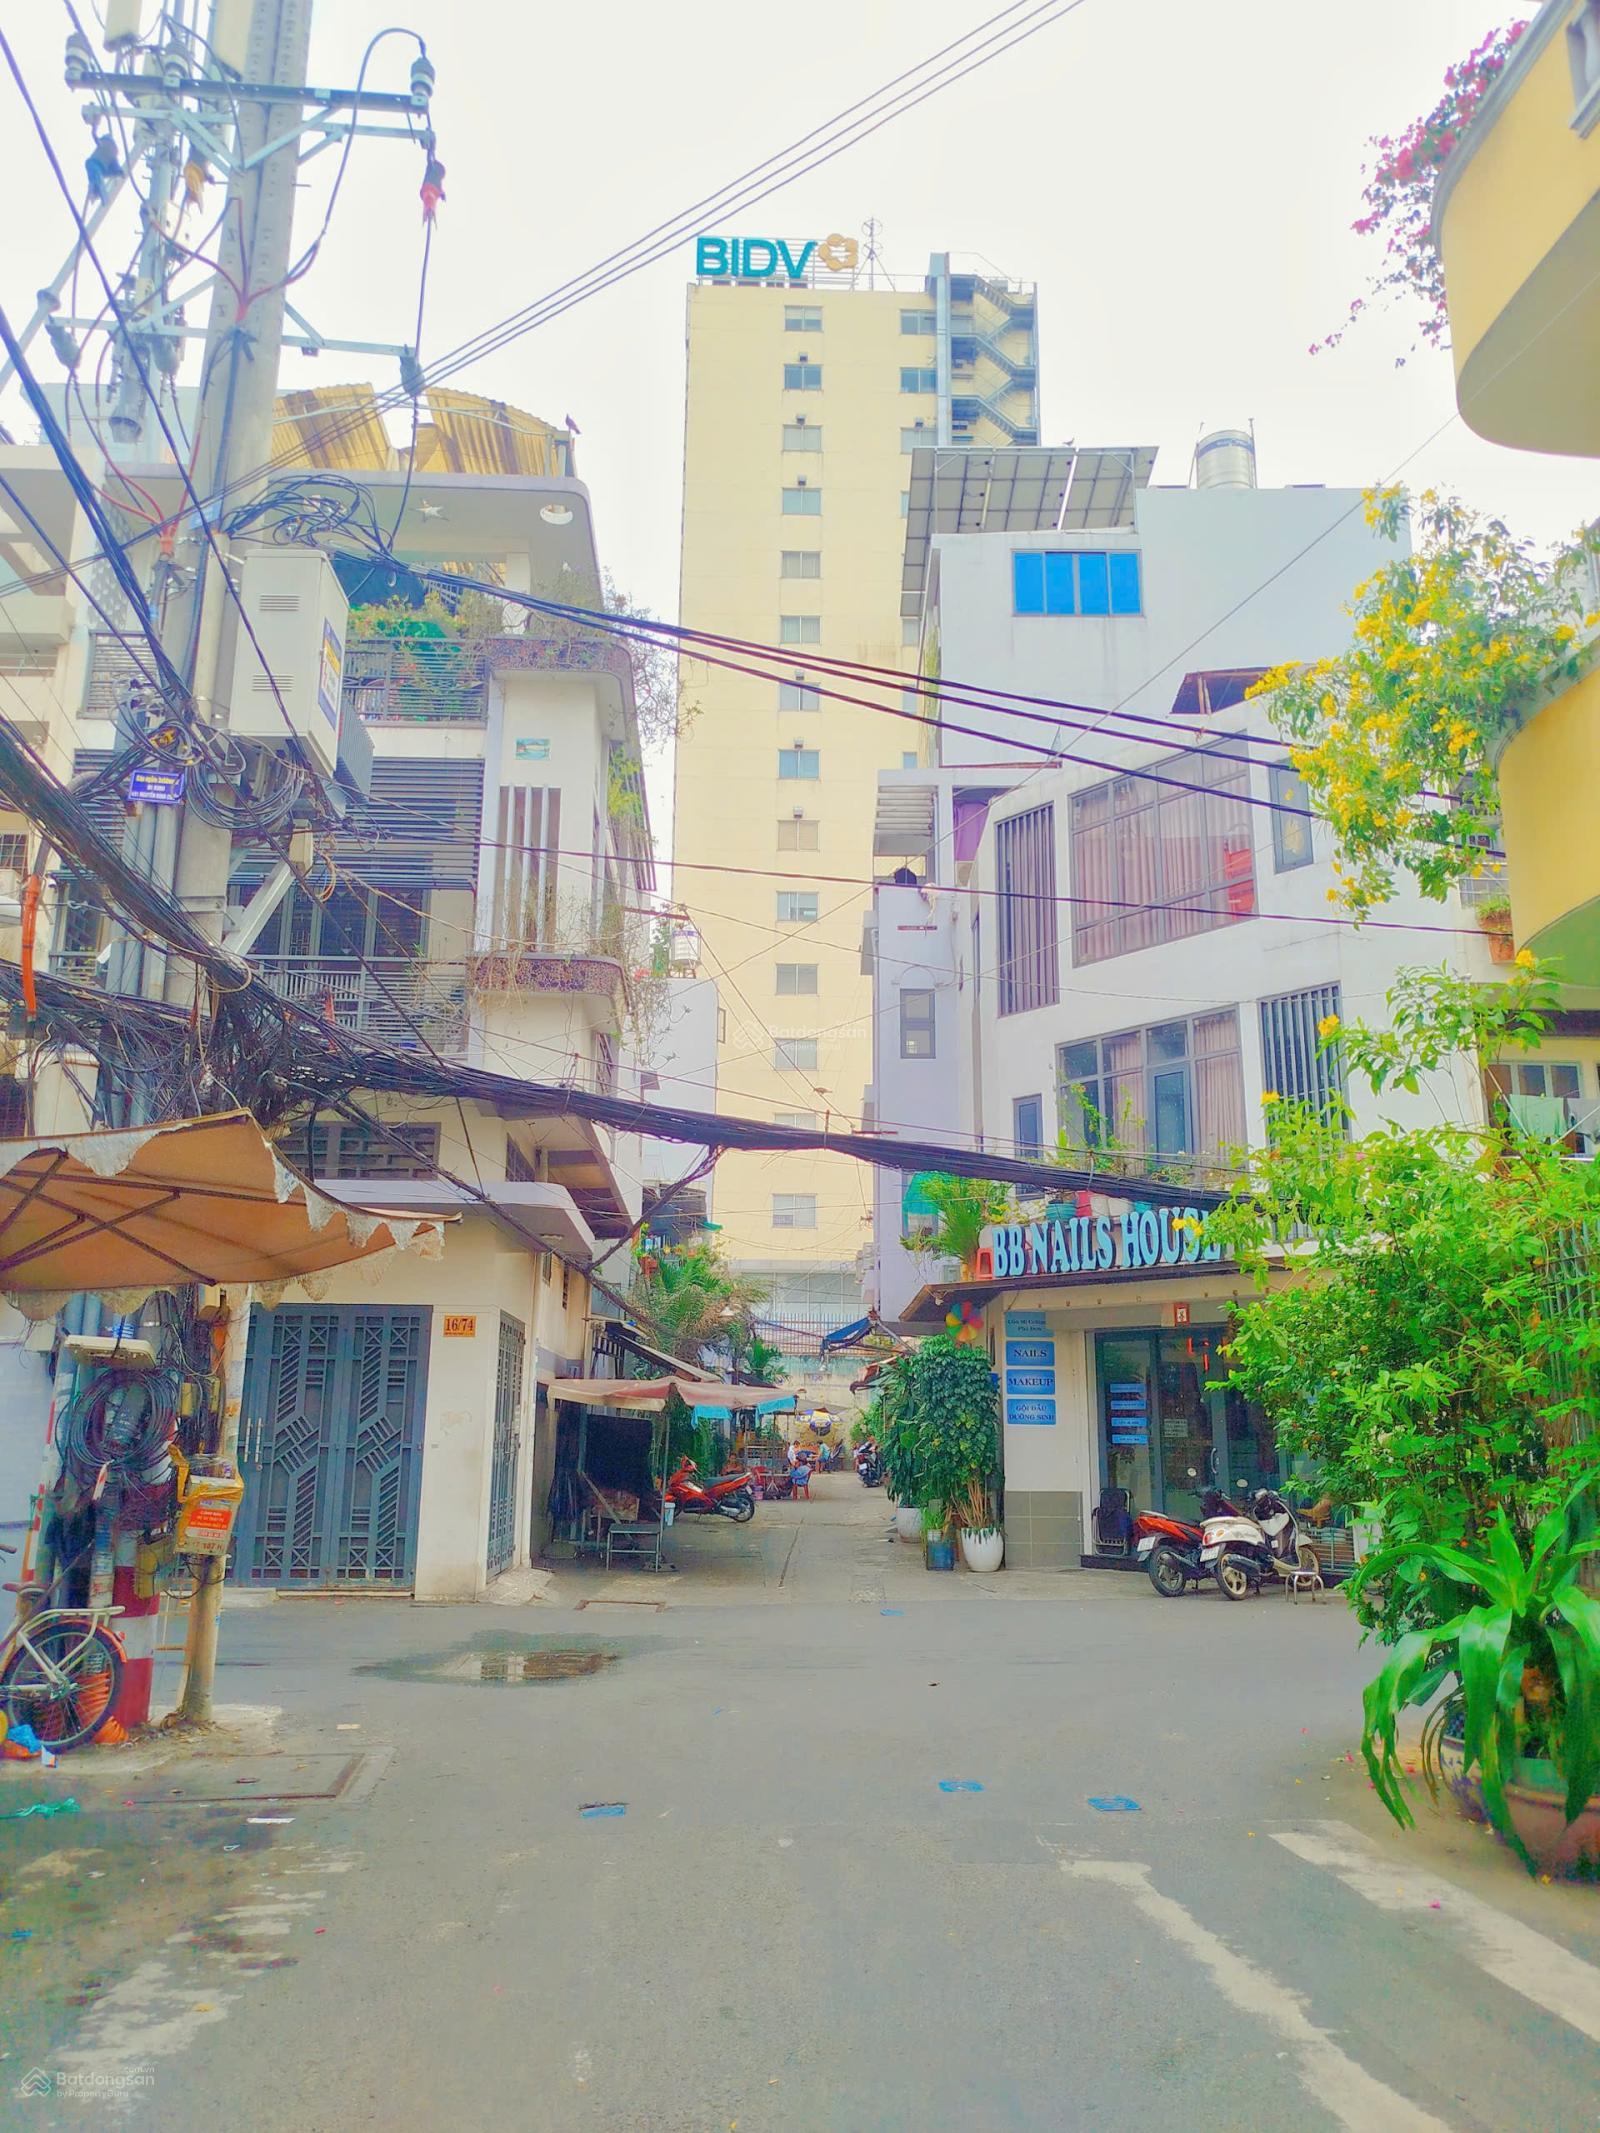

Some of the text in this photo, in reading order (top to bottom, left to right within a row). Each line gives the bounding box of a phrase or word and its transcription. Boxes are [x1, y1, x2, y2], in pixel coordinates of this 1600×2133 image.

[697, 237, 818, 278] BIDV
[992, 1225, 1025, 1277] BB
[1030, 1215, 1114, 1275] NAILS
[1013, 1349, 1048, 1358] NAILS
[1008, 1378, 1054, 1386] MAKEUP
